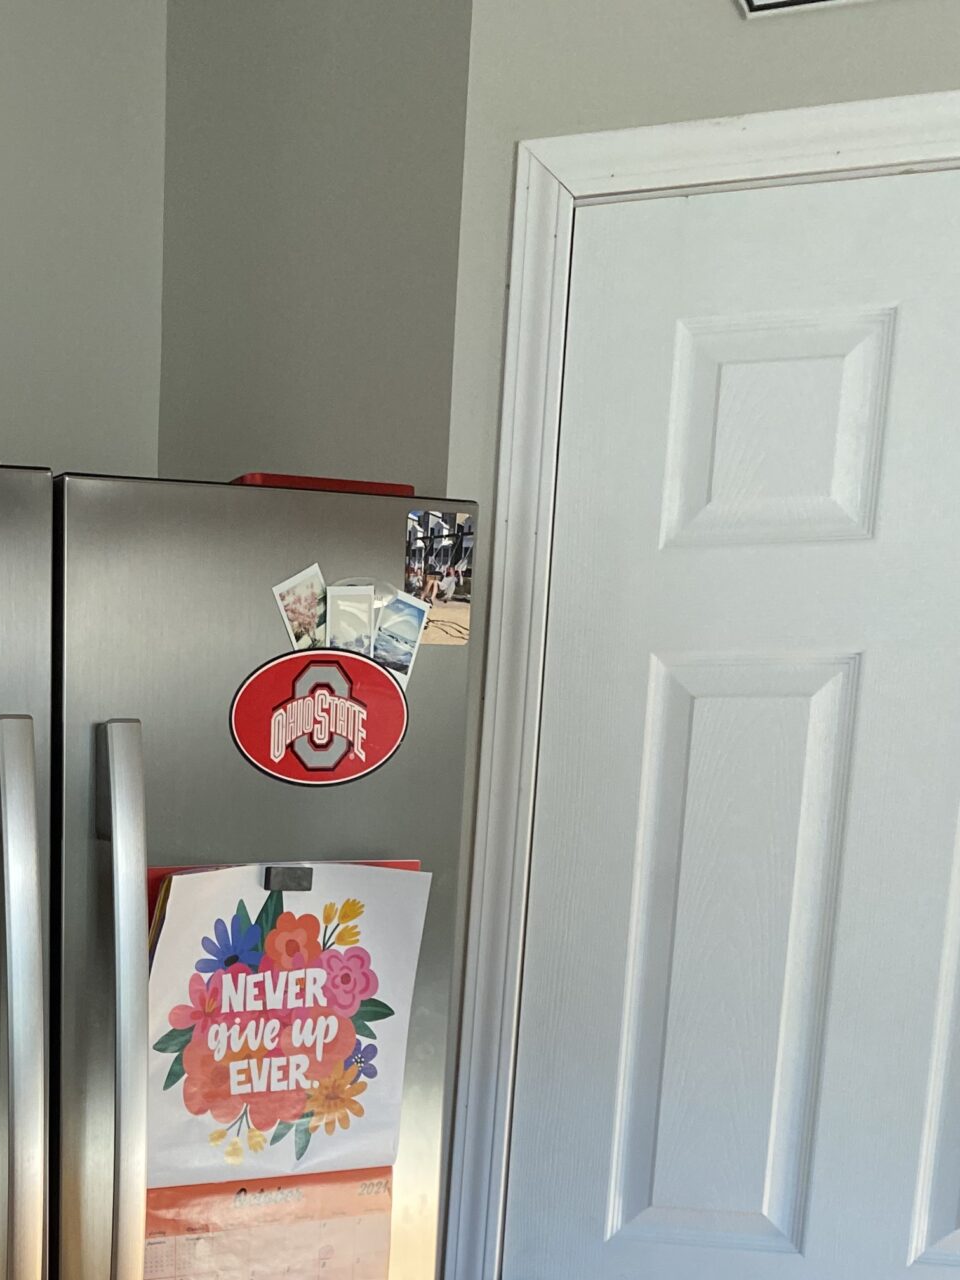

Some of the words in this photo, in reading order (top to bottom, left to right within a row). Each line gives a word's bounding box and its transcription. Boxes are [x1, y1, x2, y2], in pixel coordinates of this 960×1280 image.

[270, 696, 315, 763] OHIO
[313, 689, 367, 763] STATE
[220, 967, 329, 1014] NEVER
[207, 1017, 281, 1061] give
[291, 1015, 339, 1062] up
[229, 1053, 320, 1096] EVER.
[358, 1179, 389, 1197] 2021
